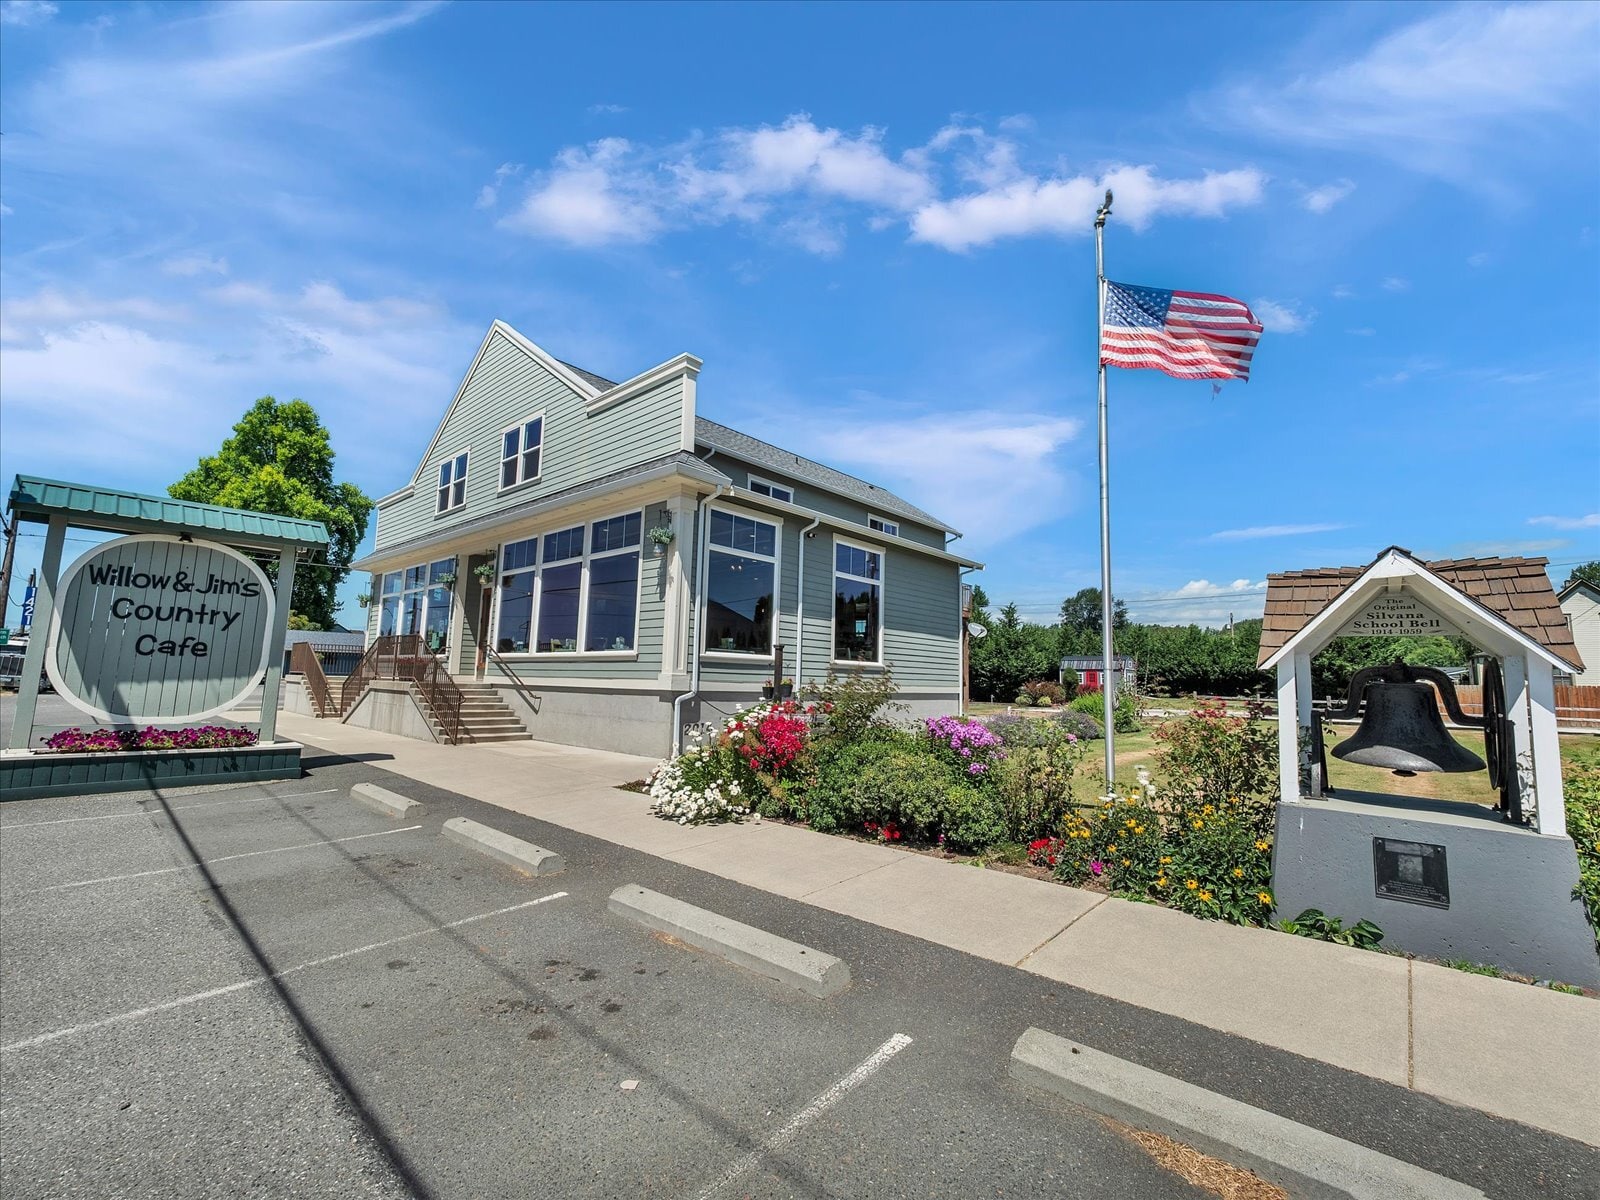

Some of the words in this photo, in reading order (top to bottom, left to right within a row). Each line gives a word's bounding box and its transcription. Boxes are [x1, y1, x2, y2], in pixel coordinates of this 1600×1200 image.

[89, 564, 171, 589] Willow
[173, 571, 195, 593] &
[195, 573, 260, 597] Jim's
[24, 587, 36, 625] 1421
[111, 597, 241, 632] Country
[1366, 612, 1424, 620] Silvana
[1353, 620, 1404, 629] School
[1409, 619, 1441, 628] Bell
[135, 633, 208, 657] Cafe
